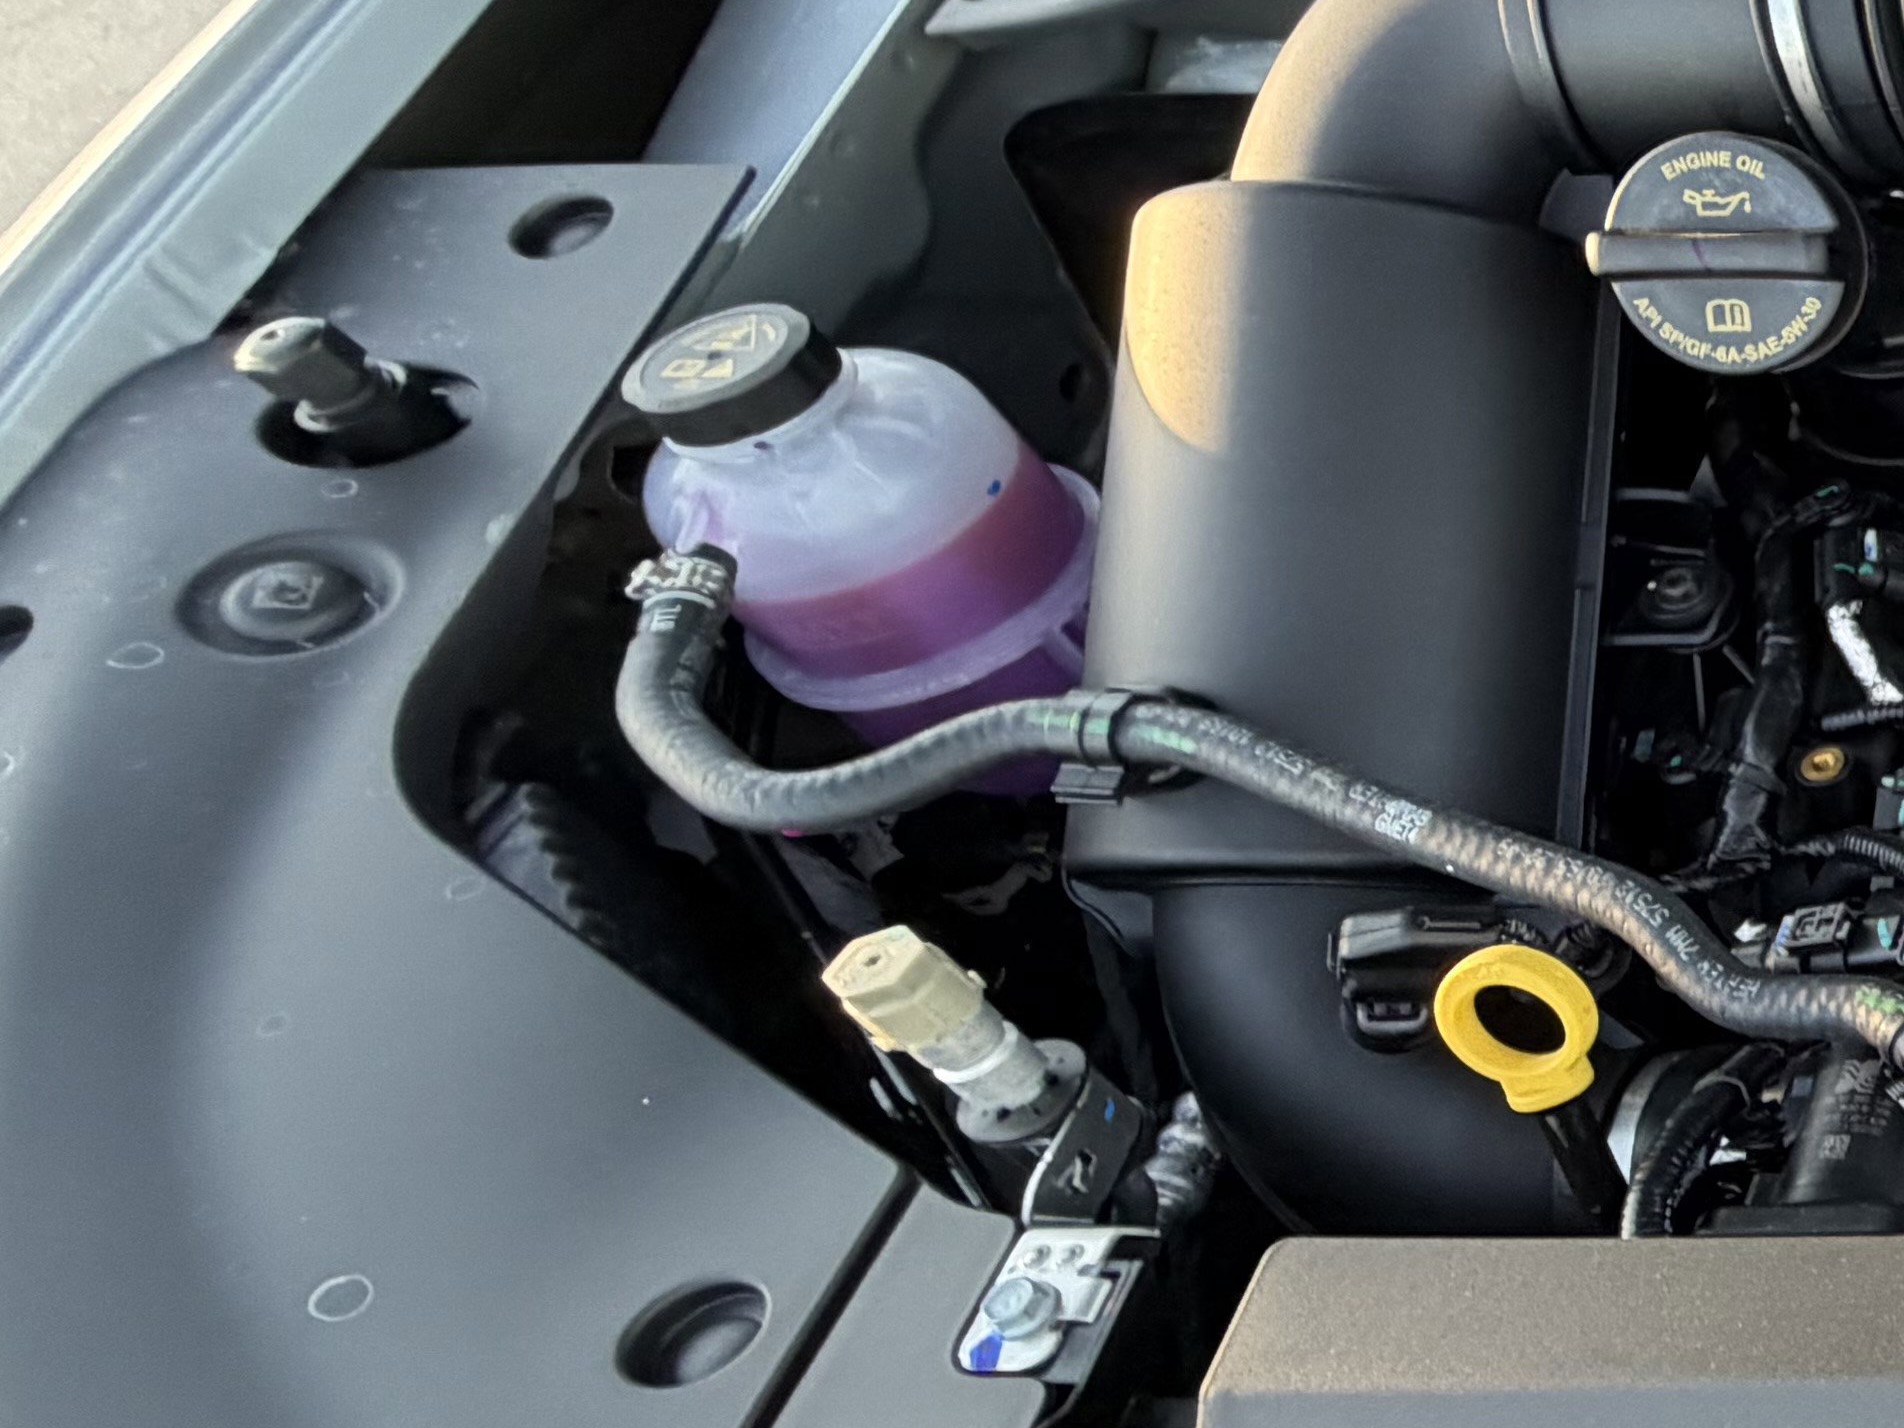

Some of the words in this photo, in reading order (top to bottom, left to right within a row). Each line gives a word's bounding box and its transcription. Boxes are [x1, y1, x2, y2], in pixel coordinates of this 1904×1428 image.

[1661, 151, 1732, 180] ENGINE
[1736, 155, 1766, 180] OIL
[1633, 297, 1662, 329] API
